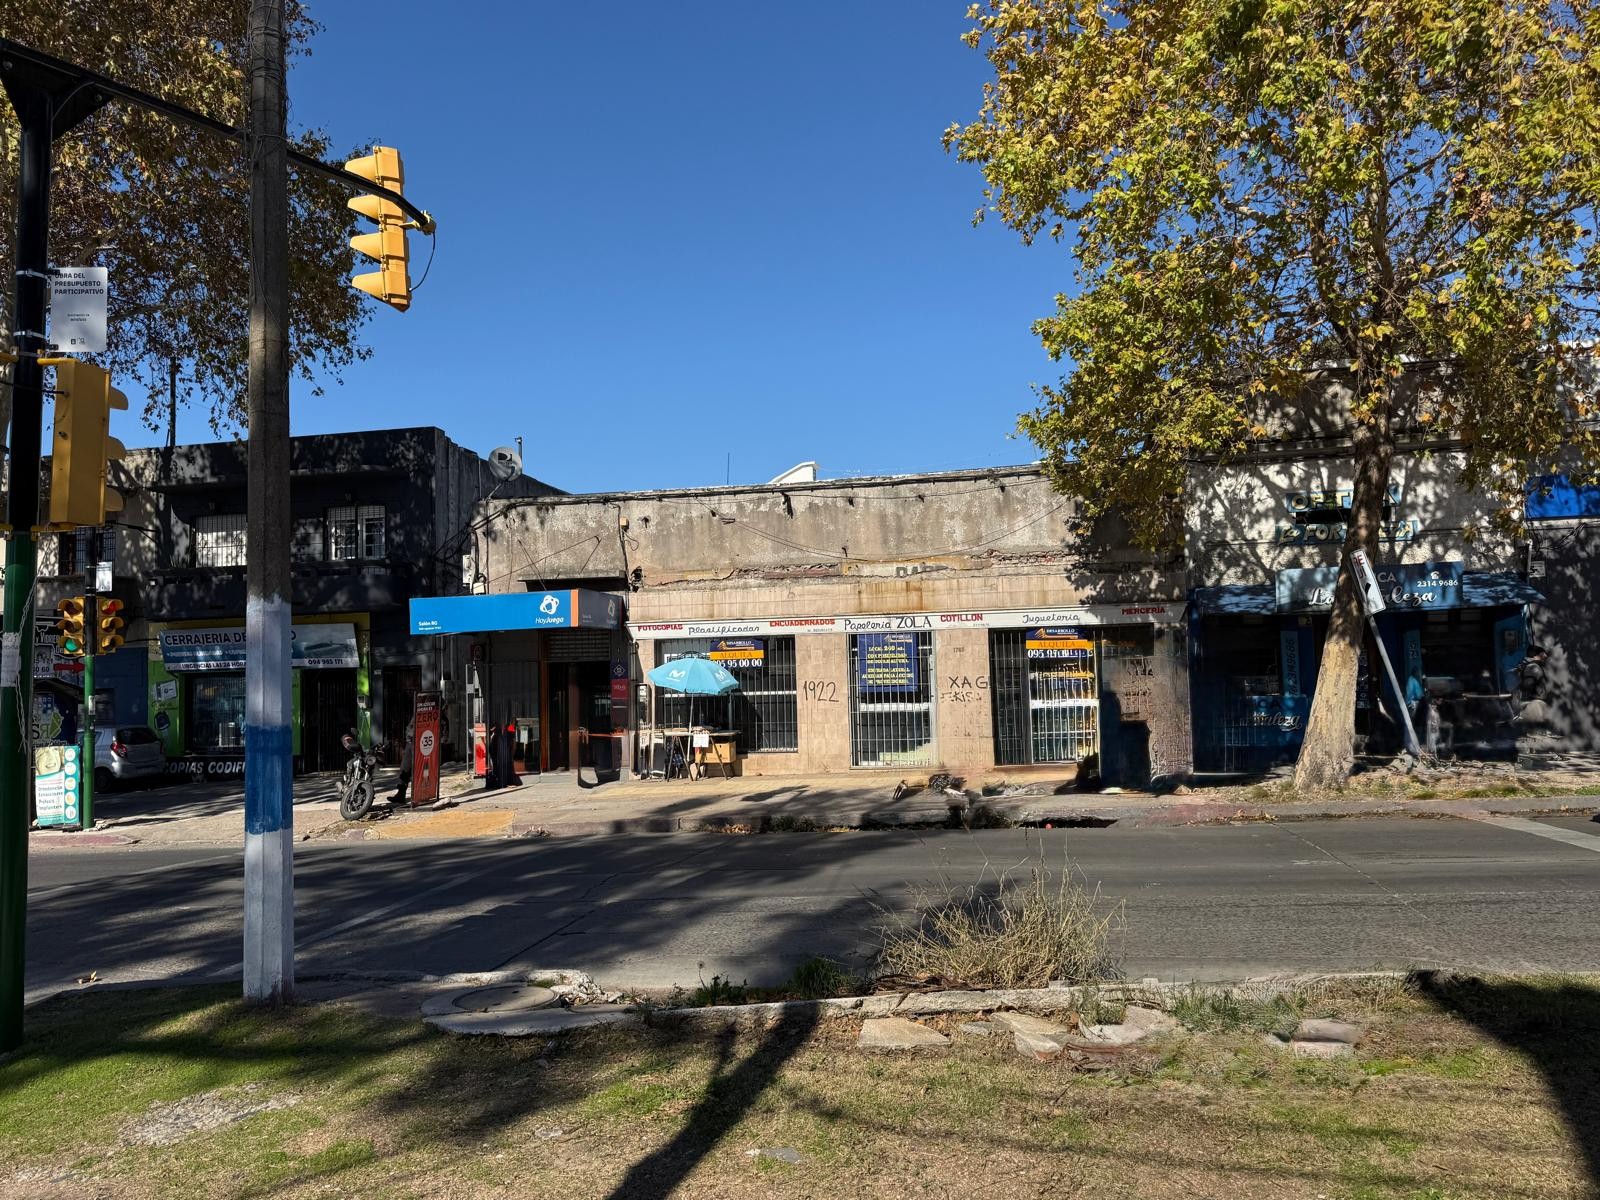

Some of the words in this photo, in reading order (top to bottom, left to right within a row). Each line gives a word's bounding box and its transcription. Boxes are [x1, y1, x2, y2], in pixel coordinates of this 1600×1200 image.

[1439, 579, 1459, 587] 9686
[769, 618, 836, 628] ENCUADERNADOS
[896, 616, 932, 628] ZOLA
[940, 613, 983, 623] COTILLON
[637, 624, 684, 632] FOTOCOPIAS
[165, 633, 232, 646] CERRAJERIA
[1027, 649, 1044, 658] 095
[728, 660, 737, 668] 95
[739, 659, 750, 668] 00
[751, 659, 763, 667] 00
[803, 680, 840, 703] 1922
[417, 712, 440, 723] ZERO
[207, 761, 245, 774] CODIFI
